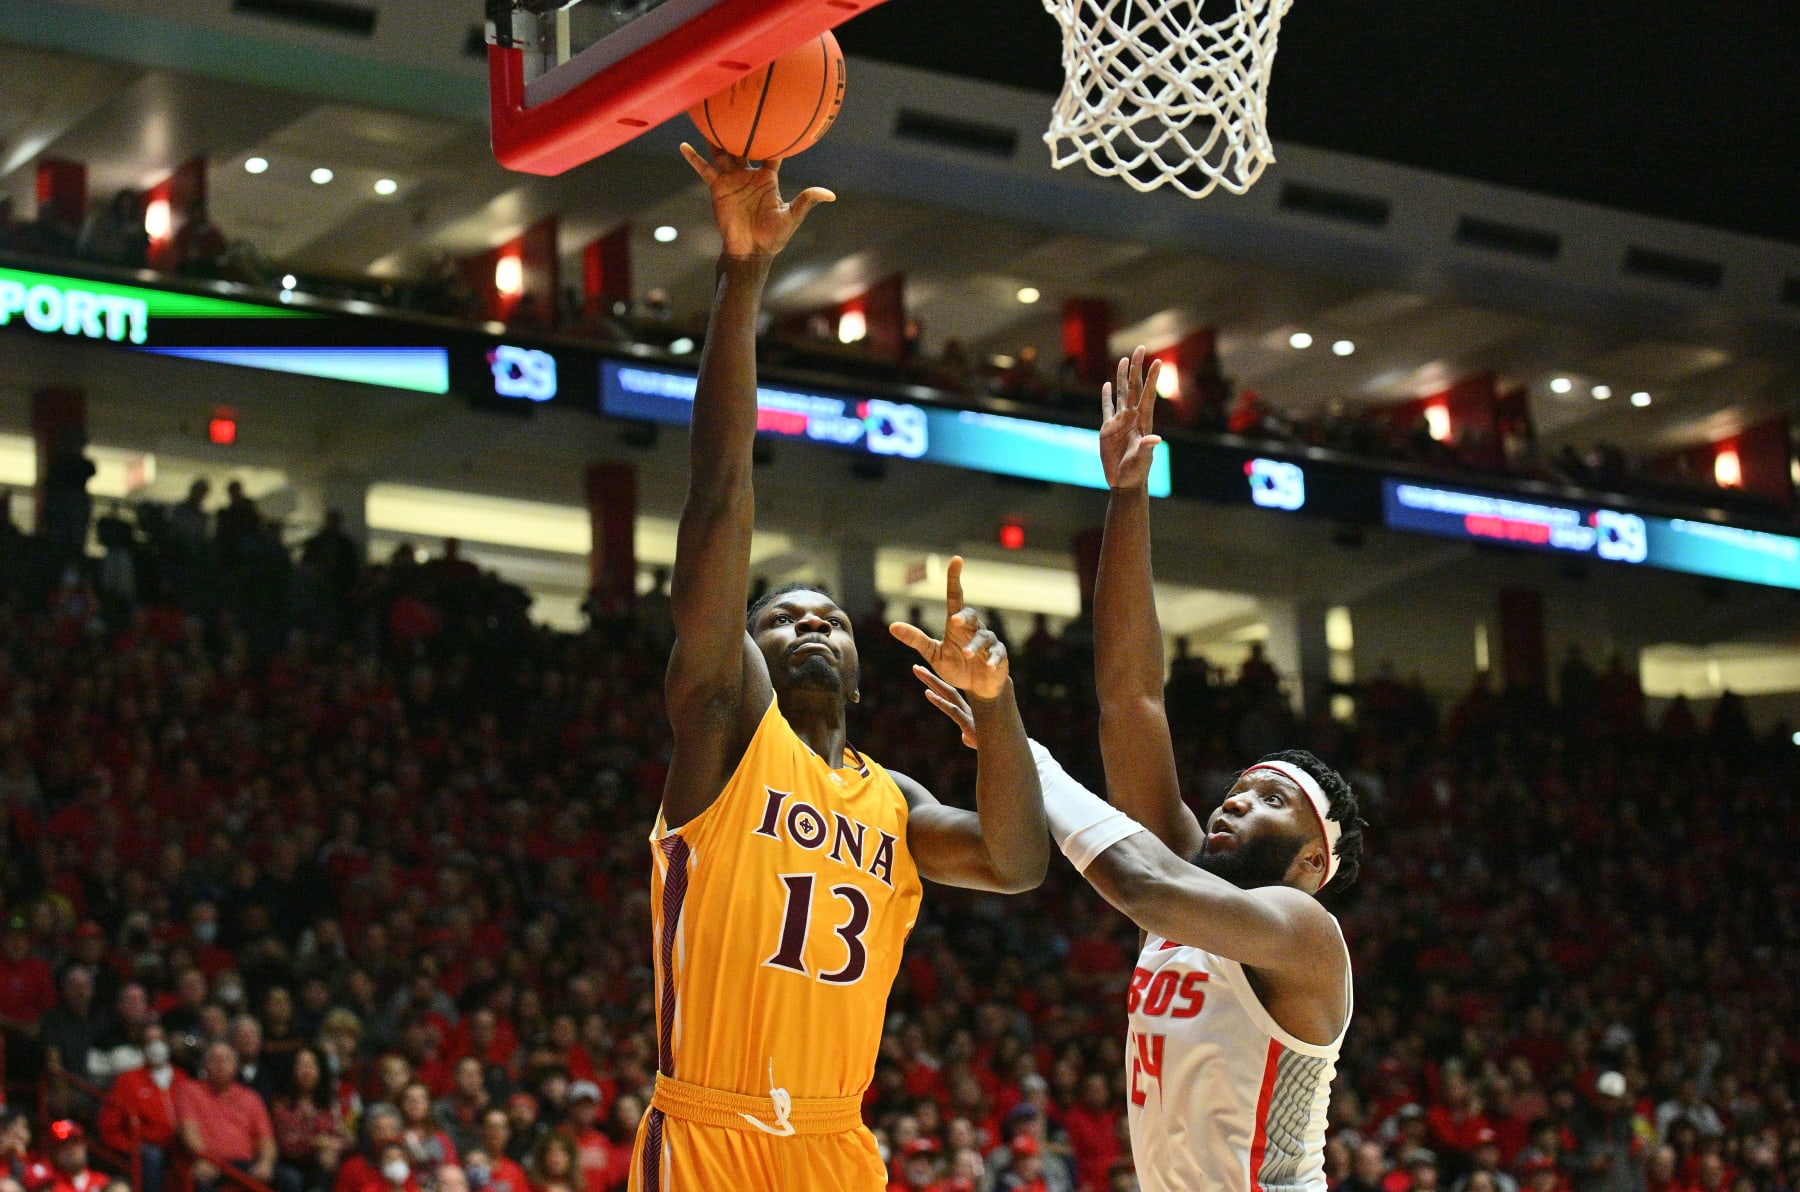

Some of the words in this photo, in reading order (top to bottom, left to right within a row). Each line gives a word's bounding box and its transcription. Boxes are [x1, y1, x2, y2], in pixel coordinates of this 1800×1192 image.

[0, 279, 148, 345] PORT!
[752, 785, 899, 890] IONA
[761, 873, 871, 985] 13
